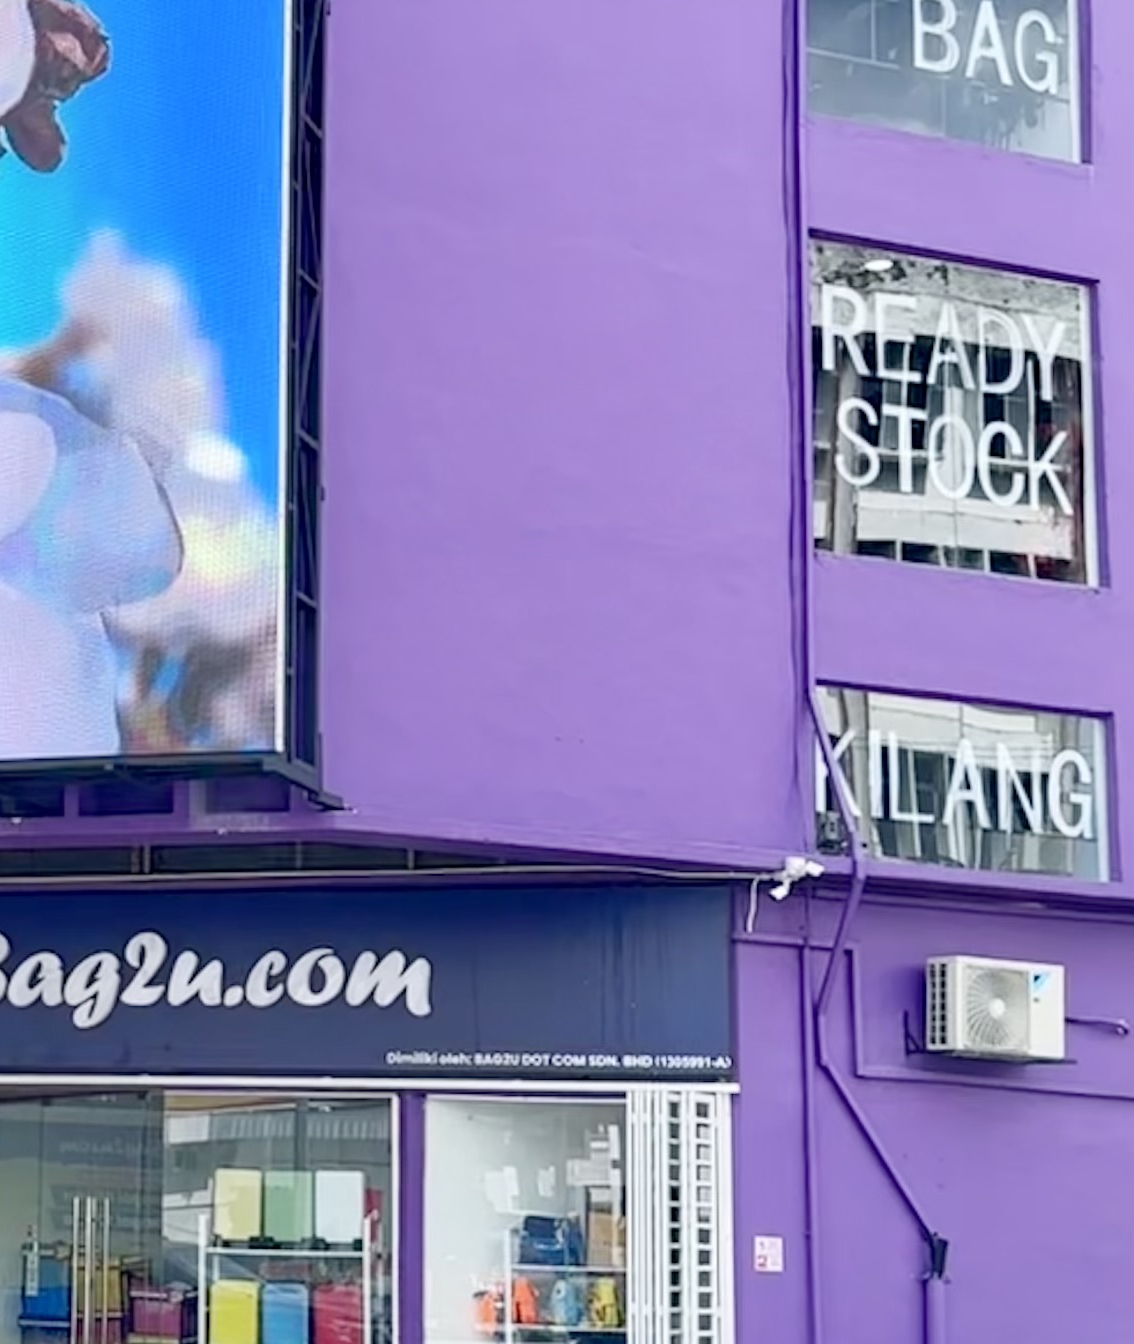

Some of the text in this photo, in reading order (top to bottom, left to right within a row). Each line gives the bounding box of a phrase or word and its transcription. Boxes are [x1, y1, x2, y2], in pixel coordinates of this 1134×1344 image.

[821, 284, 1066, 401] READY
[835, 397, 1073, 515] STOCK
[816, 728, 1094, 839] KILANG
[521, 1053, 551, 1066] DOT
[551, 1054, 586, 1067] COM
[623, 1055, 653, 1068] BHD
